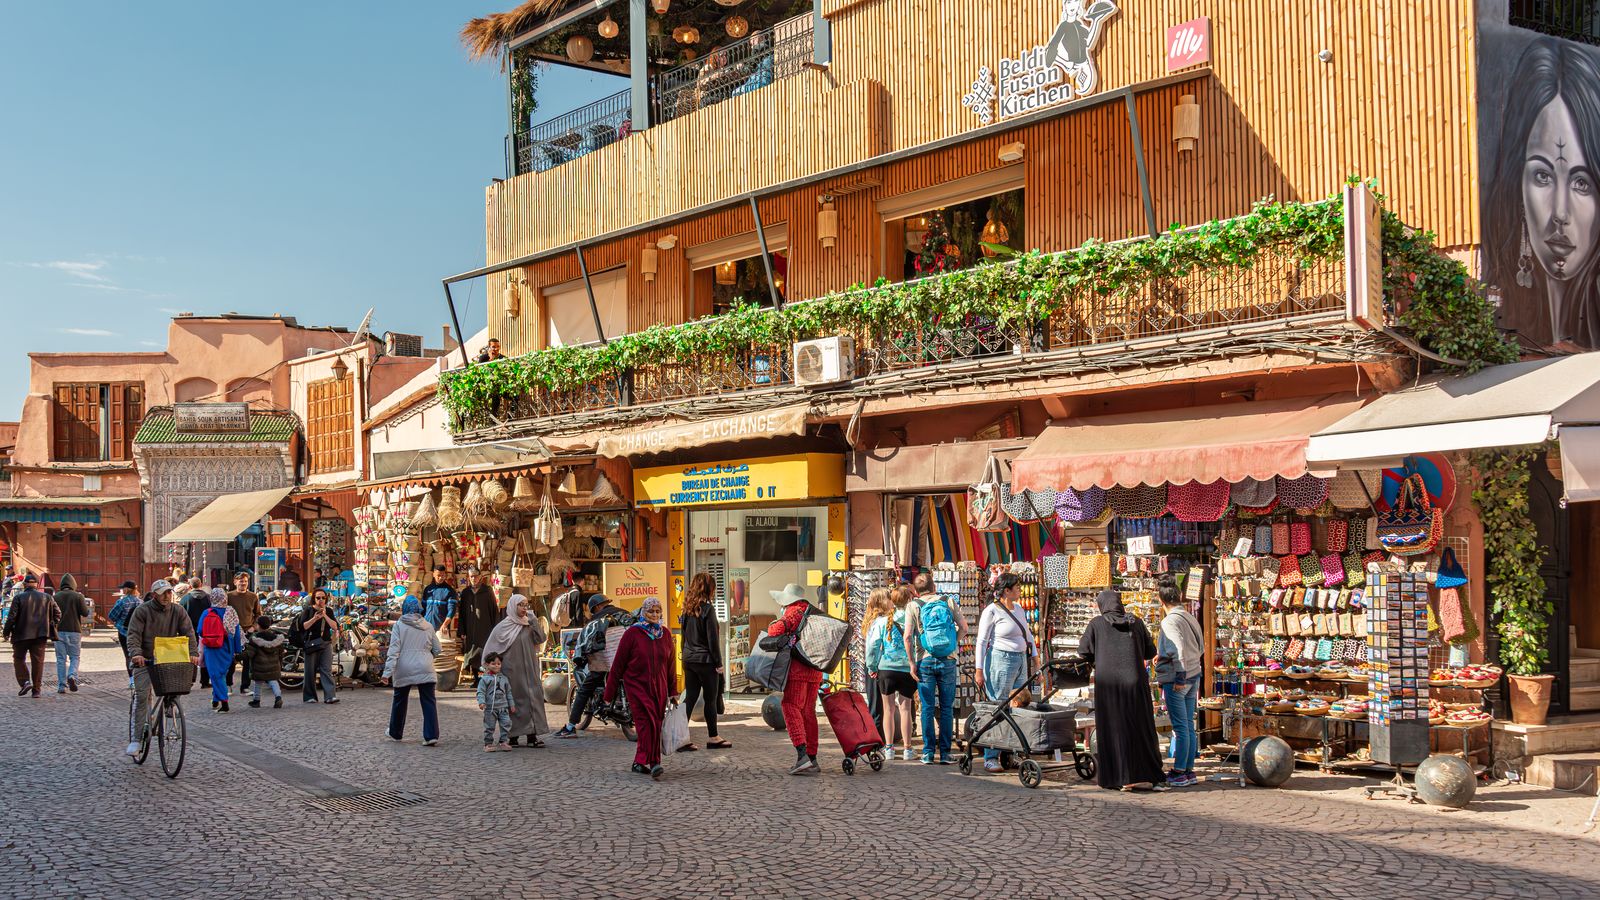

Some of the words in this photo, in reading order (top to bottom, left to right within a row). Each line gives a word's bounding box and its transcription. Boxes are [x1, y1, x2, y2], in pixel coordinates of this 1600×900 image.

[1170, 27, 1203, 60] illy
[1000, 48, 1043, 79] Beldi
[1000, 68, 1058, 97] Fusion
[1000, 85, 1070, 117] Kitchen
[619, 430, 666, 450] CHANGE
[703, 413, 776, 439] EXCHANGE
[670, 490, 708, 504] CURRENCY
[710, 487, 746, 502] EXCHANG
[681, 479, 709, 491] BUREAU
[710, 478, 720, 489] DE
[720, 476, 750, 488] CHANGE
[615, 587, 658, 596] EXCHANGE
